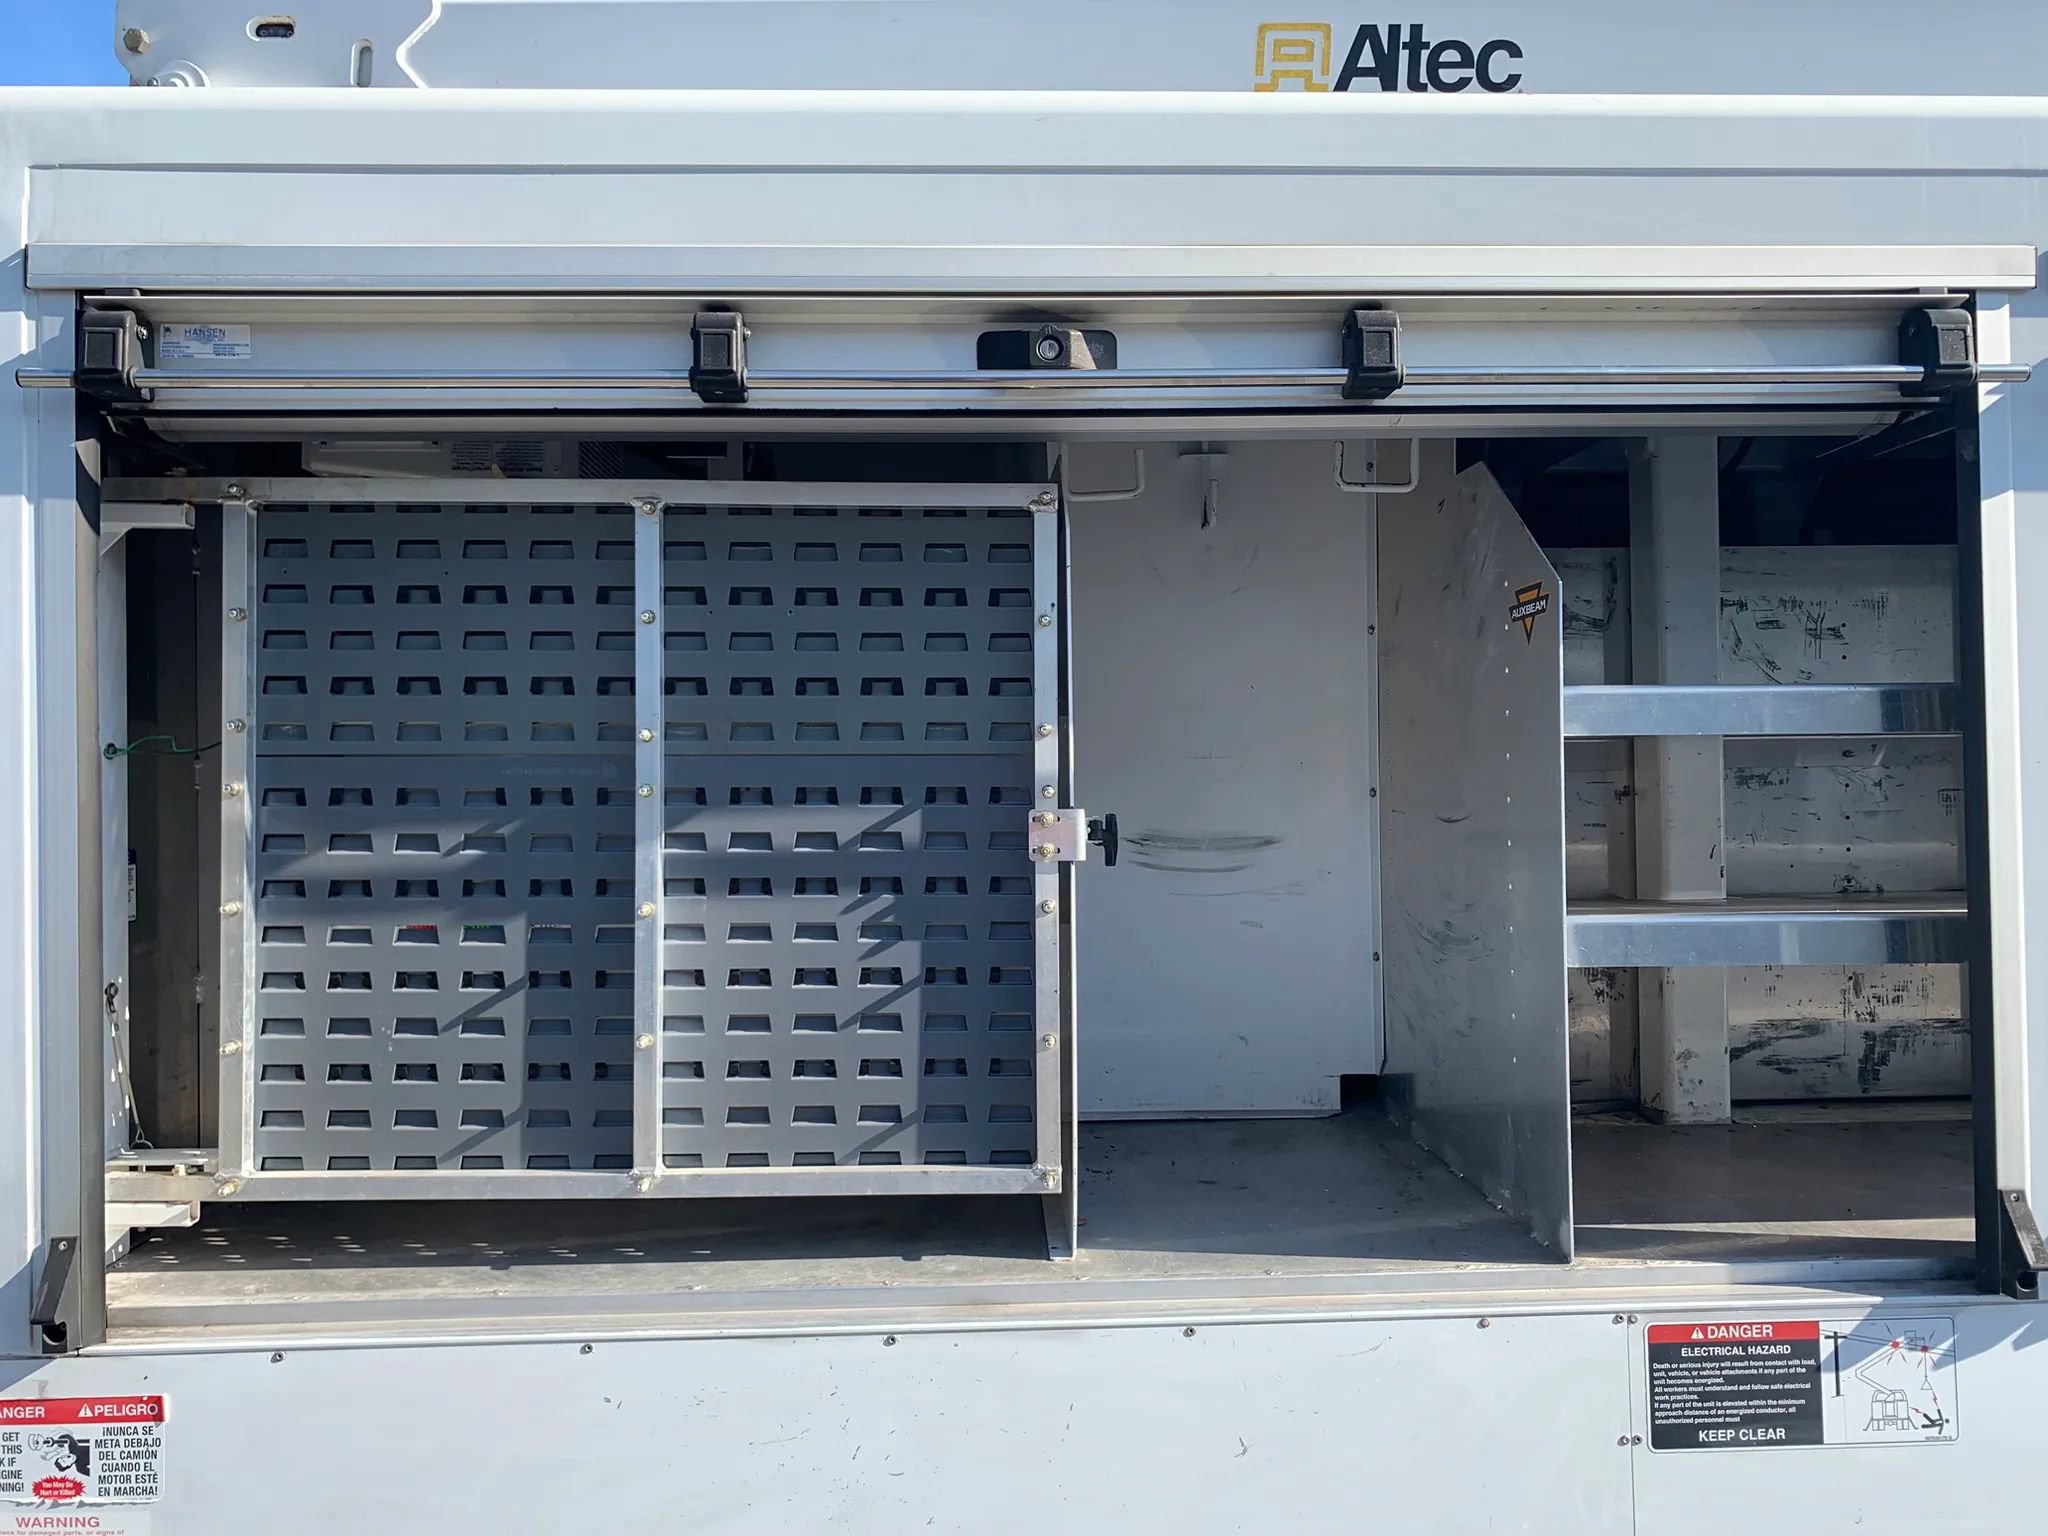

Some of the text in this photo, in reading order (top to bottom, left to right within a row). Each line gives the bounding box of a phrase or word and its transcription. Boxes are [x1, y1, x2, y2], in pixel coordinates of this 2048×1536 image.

[1333, 23, 1524, 93] Altec
[184, 328, 226, 338] HANSEN
[1512, 600, 1546, 619] AUXBEAM
[1707, 1324, 1773, 1338] DANGER
[1681, 1345, 1791, 1356] ELECTRICAL HAZARD
[94, 1403, 158, 1416] PELIGRO
[102, 1426, 154, 1436] ¡NUNCA SE
[1698, 1428, 1786, 1442] KEEP CLEAR
[2, 1432, 20, 1442] GET
[95, 1438, 161, 1448] META DEBAJO
[1, 1445, 23, 1454] THIS
[98, 1448, 158, 1461] DEL CAMIÓN
[8, 1458, 16, 1467] IF
[101, 1462, 155, 1472] CUANDO EL
[98, 1471, 158, 1485] MOTOR ESTÉ
[98, 1486, 158, 1496] EN MARCHA!
[16, 1516, 100, 1528] WARNING
